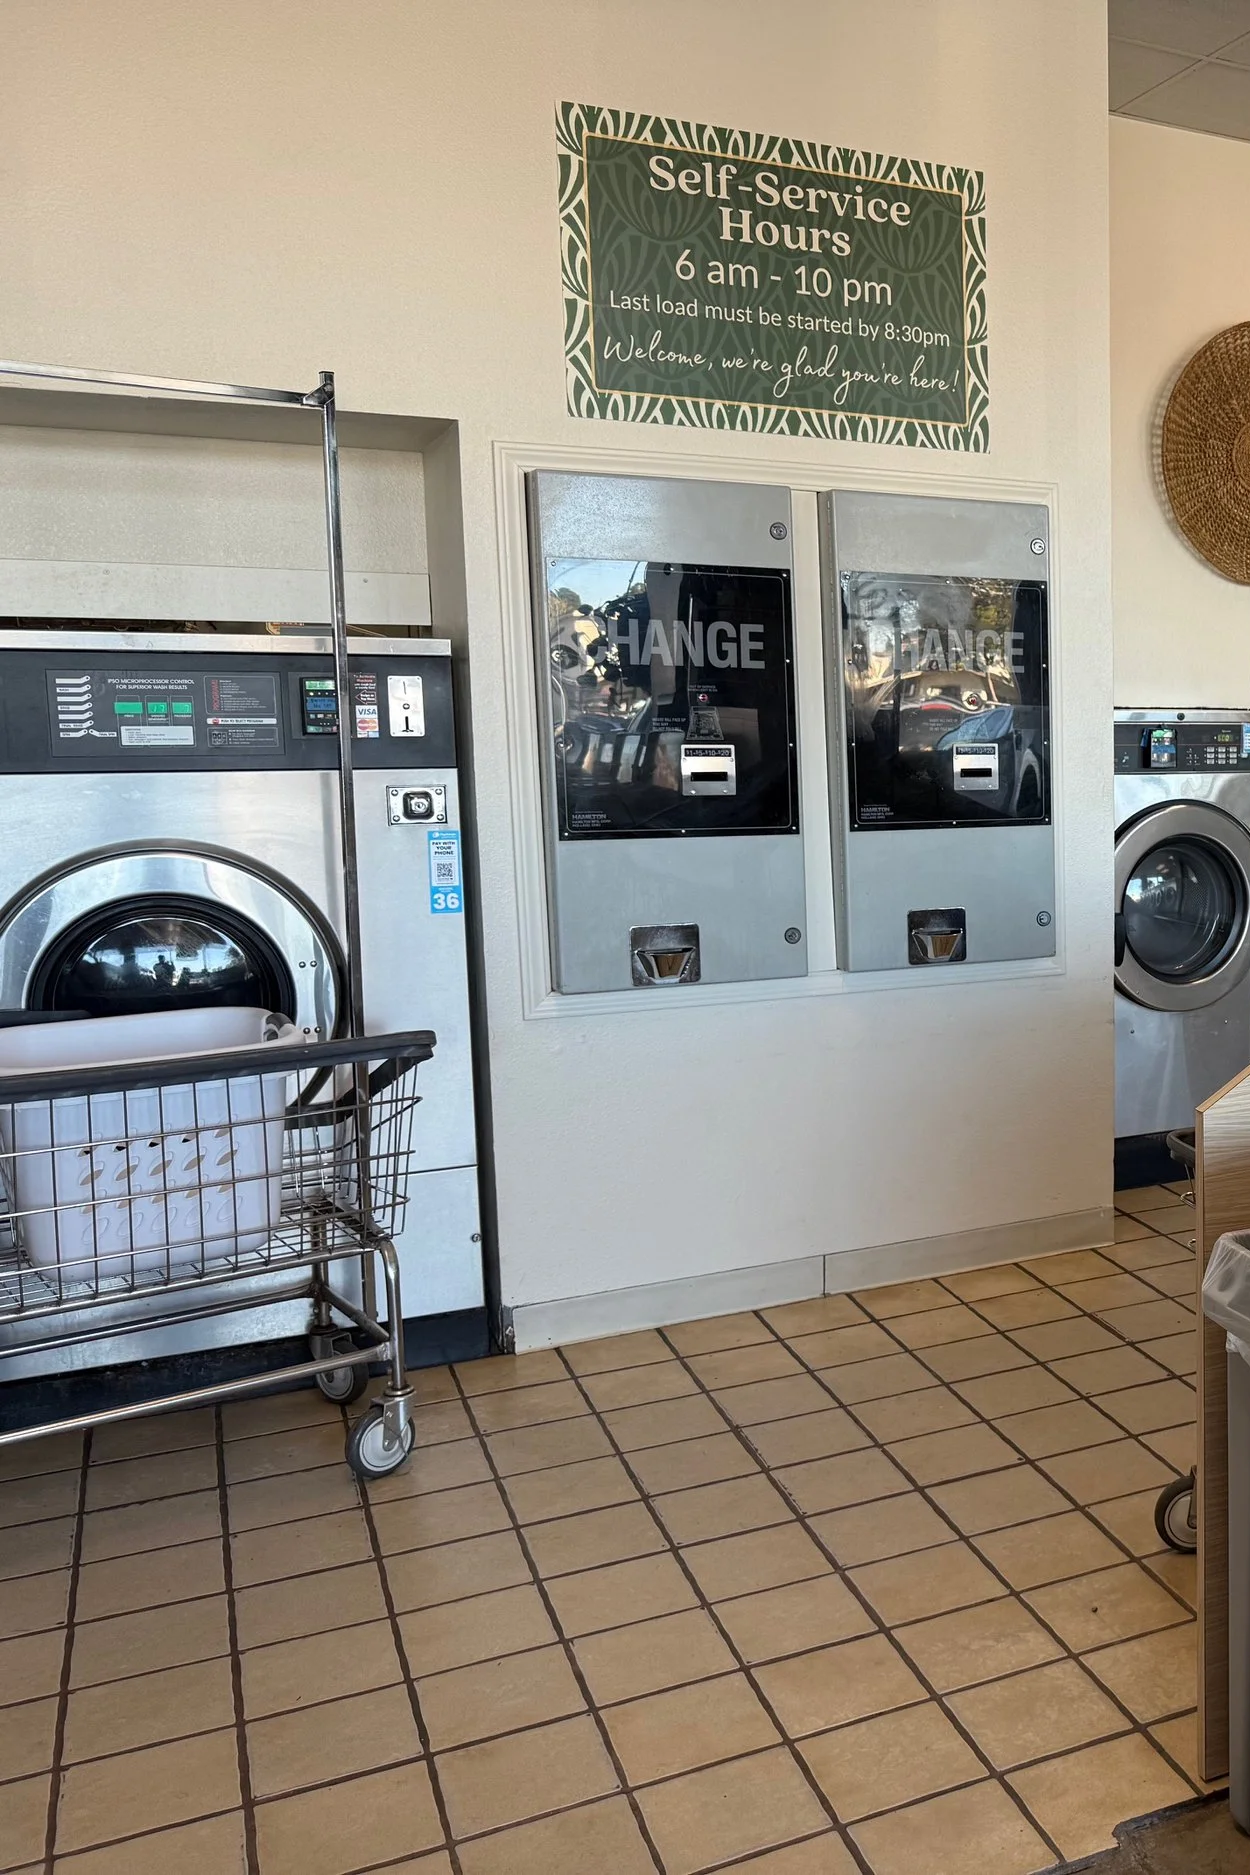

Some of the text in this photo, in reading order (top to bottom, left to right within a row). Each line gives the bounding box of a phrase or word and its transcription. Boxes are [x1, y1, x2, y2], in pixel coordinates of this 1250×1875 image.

[648, 155, 912, 227] Self-Service
[718, 206, 851, 257] Hours
[675, 248, 696, 281] 6
[706, 260, 759, 289] am
[794, 265, 833, 298] 10
[842, 277, 893, 307] pm
[609, 289, 951, 348] Last load must be started by 8:30pm
[603, 329, 961, 406] Welcome, we're glad you're here!
[892, 627, 1025, 674] HANGE
[357, 708, 377, 716] VISA
[432, 892, 460, 910] 36
